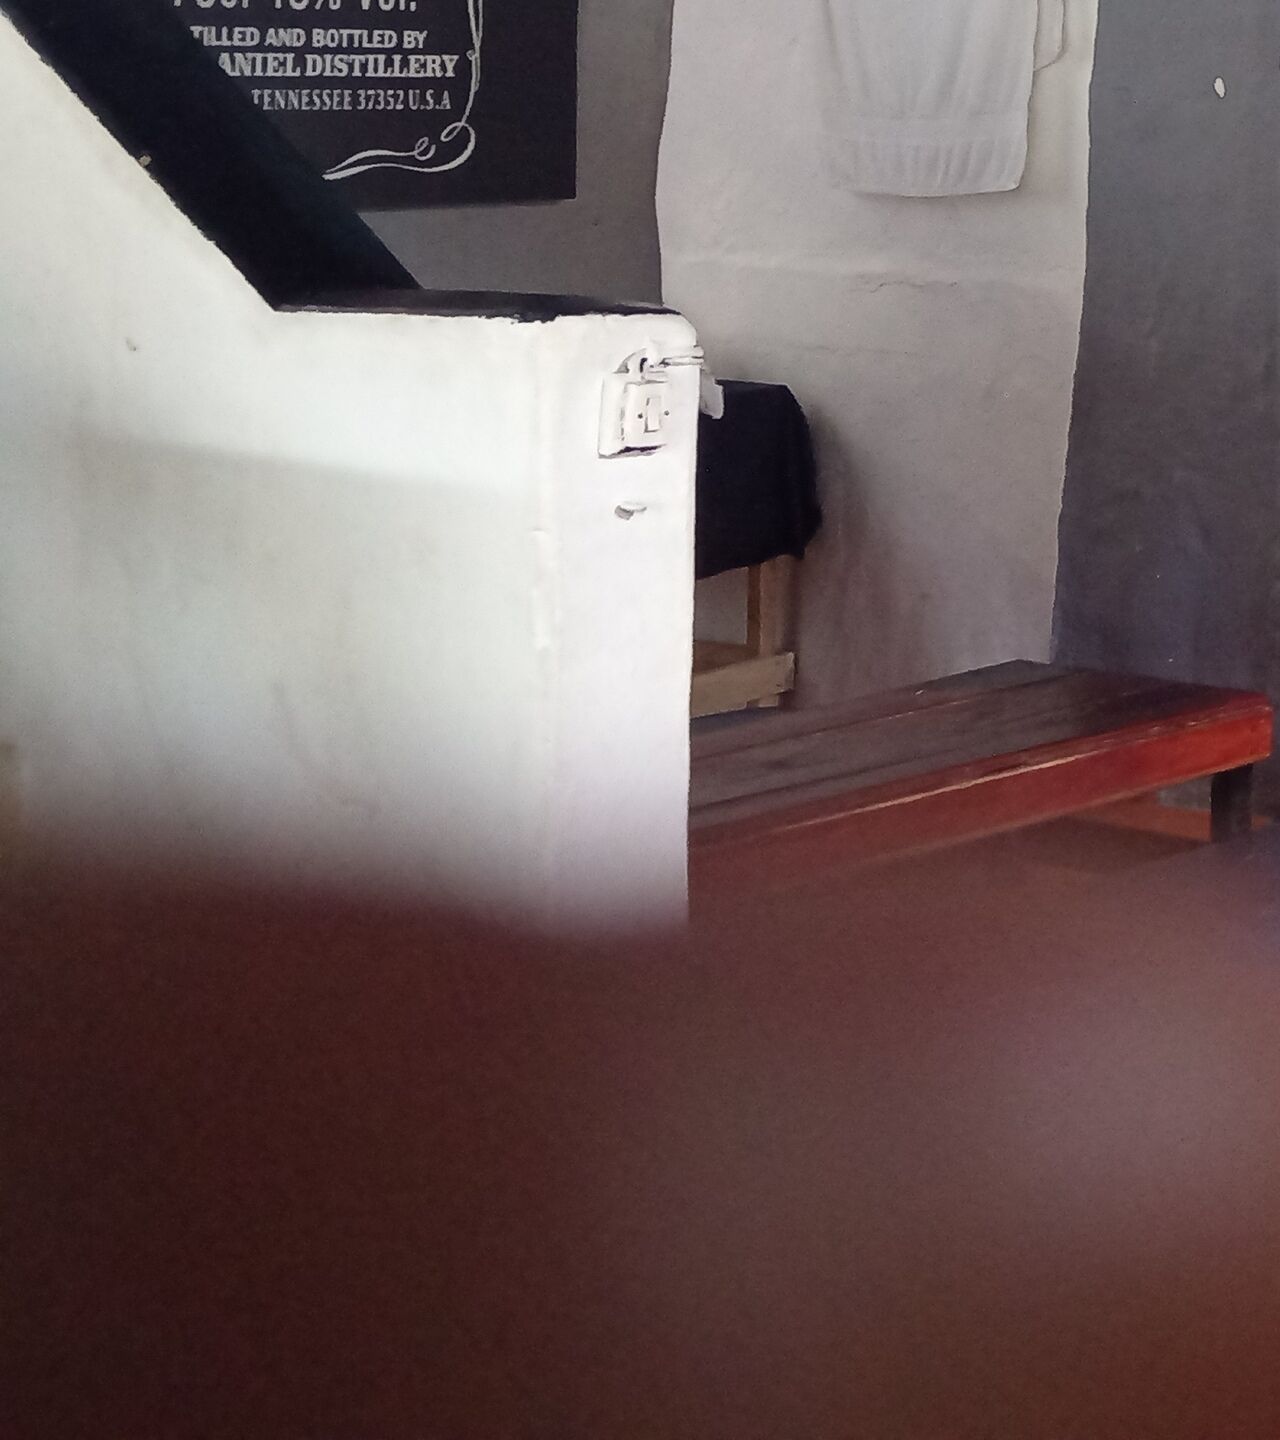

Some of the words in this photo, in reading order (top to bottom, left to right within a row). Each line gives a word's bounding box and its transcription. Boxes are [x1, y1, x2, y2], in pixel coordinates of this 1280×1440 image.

[190, 26, 260, 46] TILLED
[264, 28, 306, 47] AND
[312, 28, 398, 49] BOTTLED
[402, 30, 428, 49] BY
[218, 52, 300, 77] ANIEL
[304, 53, 460, 78] DISTILLERY
[251, 89, 352, 110] TENNESSEE
[356, 89, 404, 110] 37352
